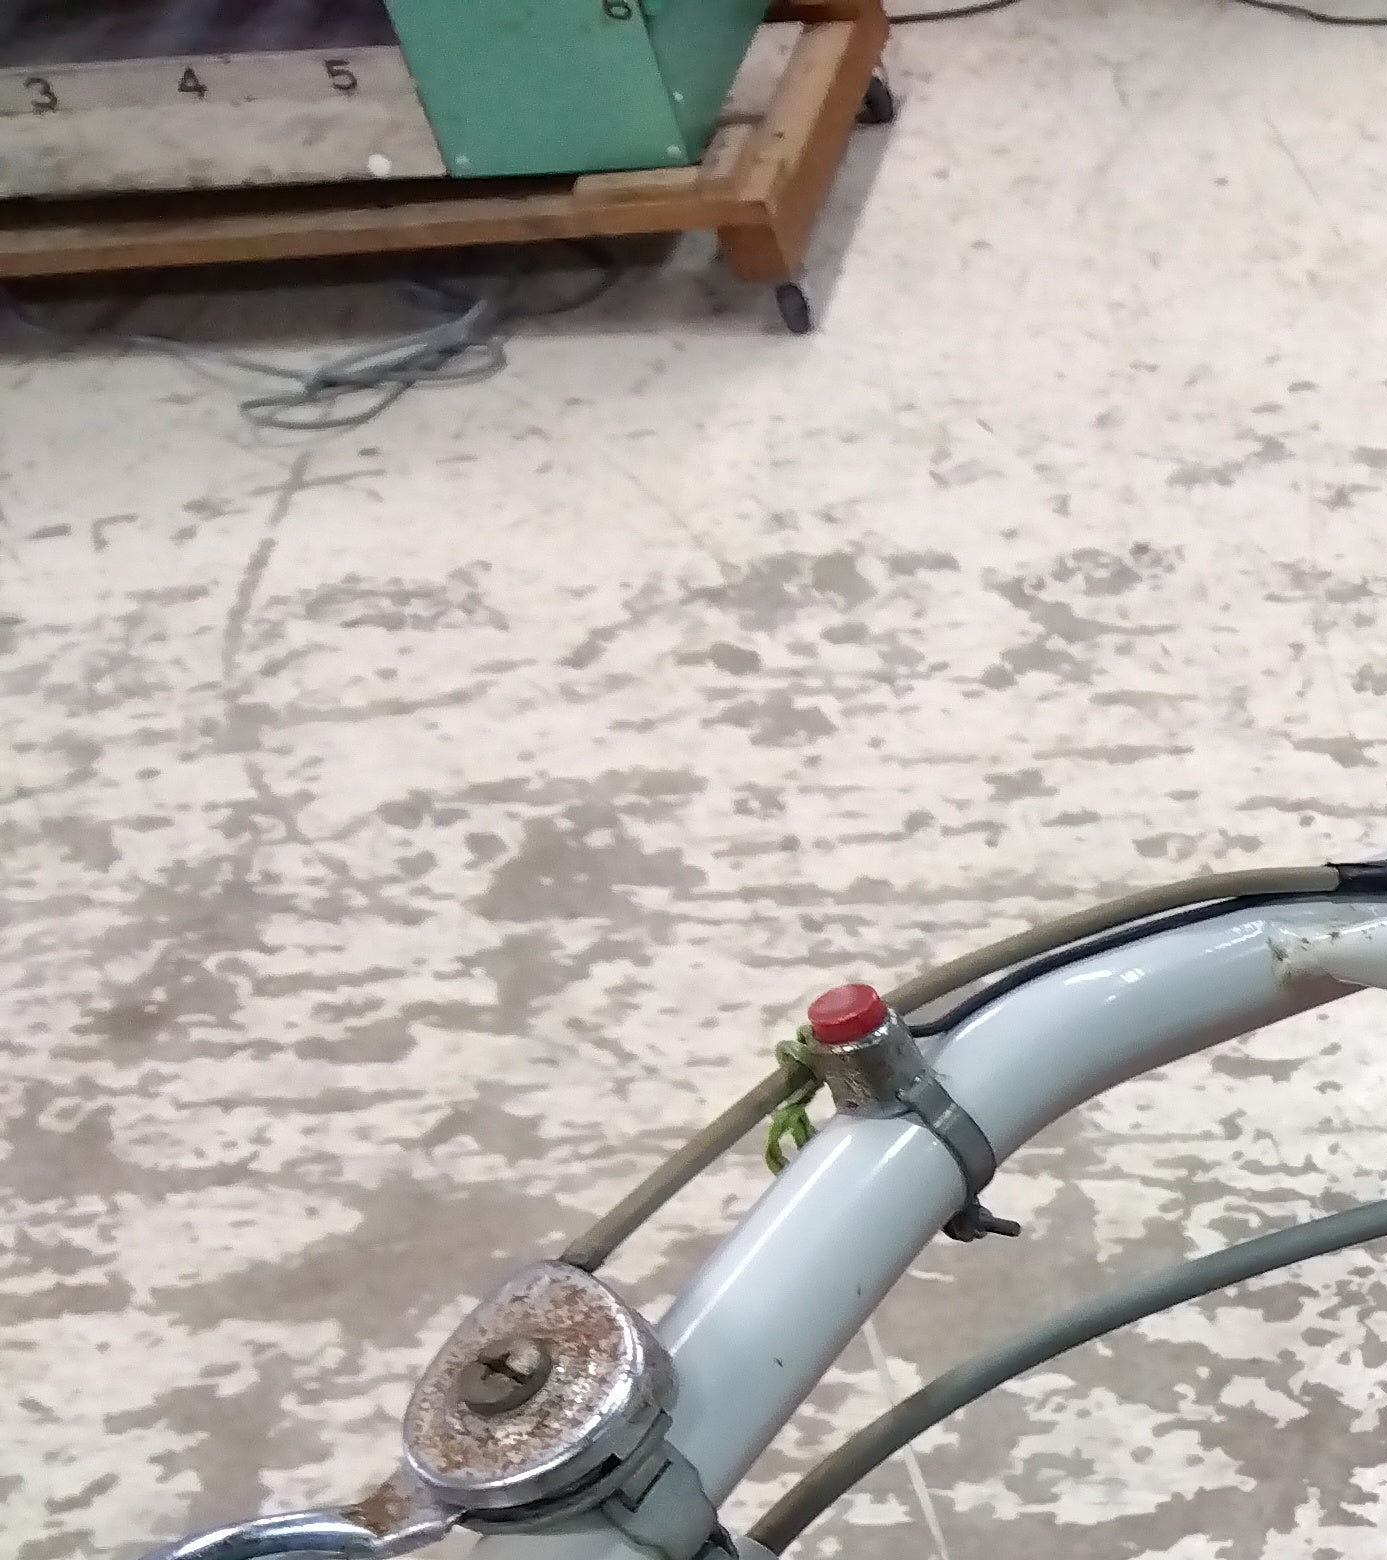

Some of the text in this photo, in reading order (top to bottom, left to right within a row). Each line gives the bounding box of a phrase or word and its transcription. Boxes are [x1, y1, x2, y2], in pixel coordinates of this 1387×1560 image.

[23, 58, 358, 113] 3 4 5
